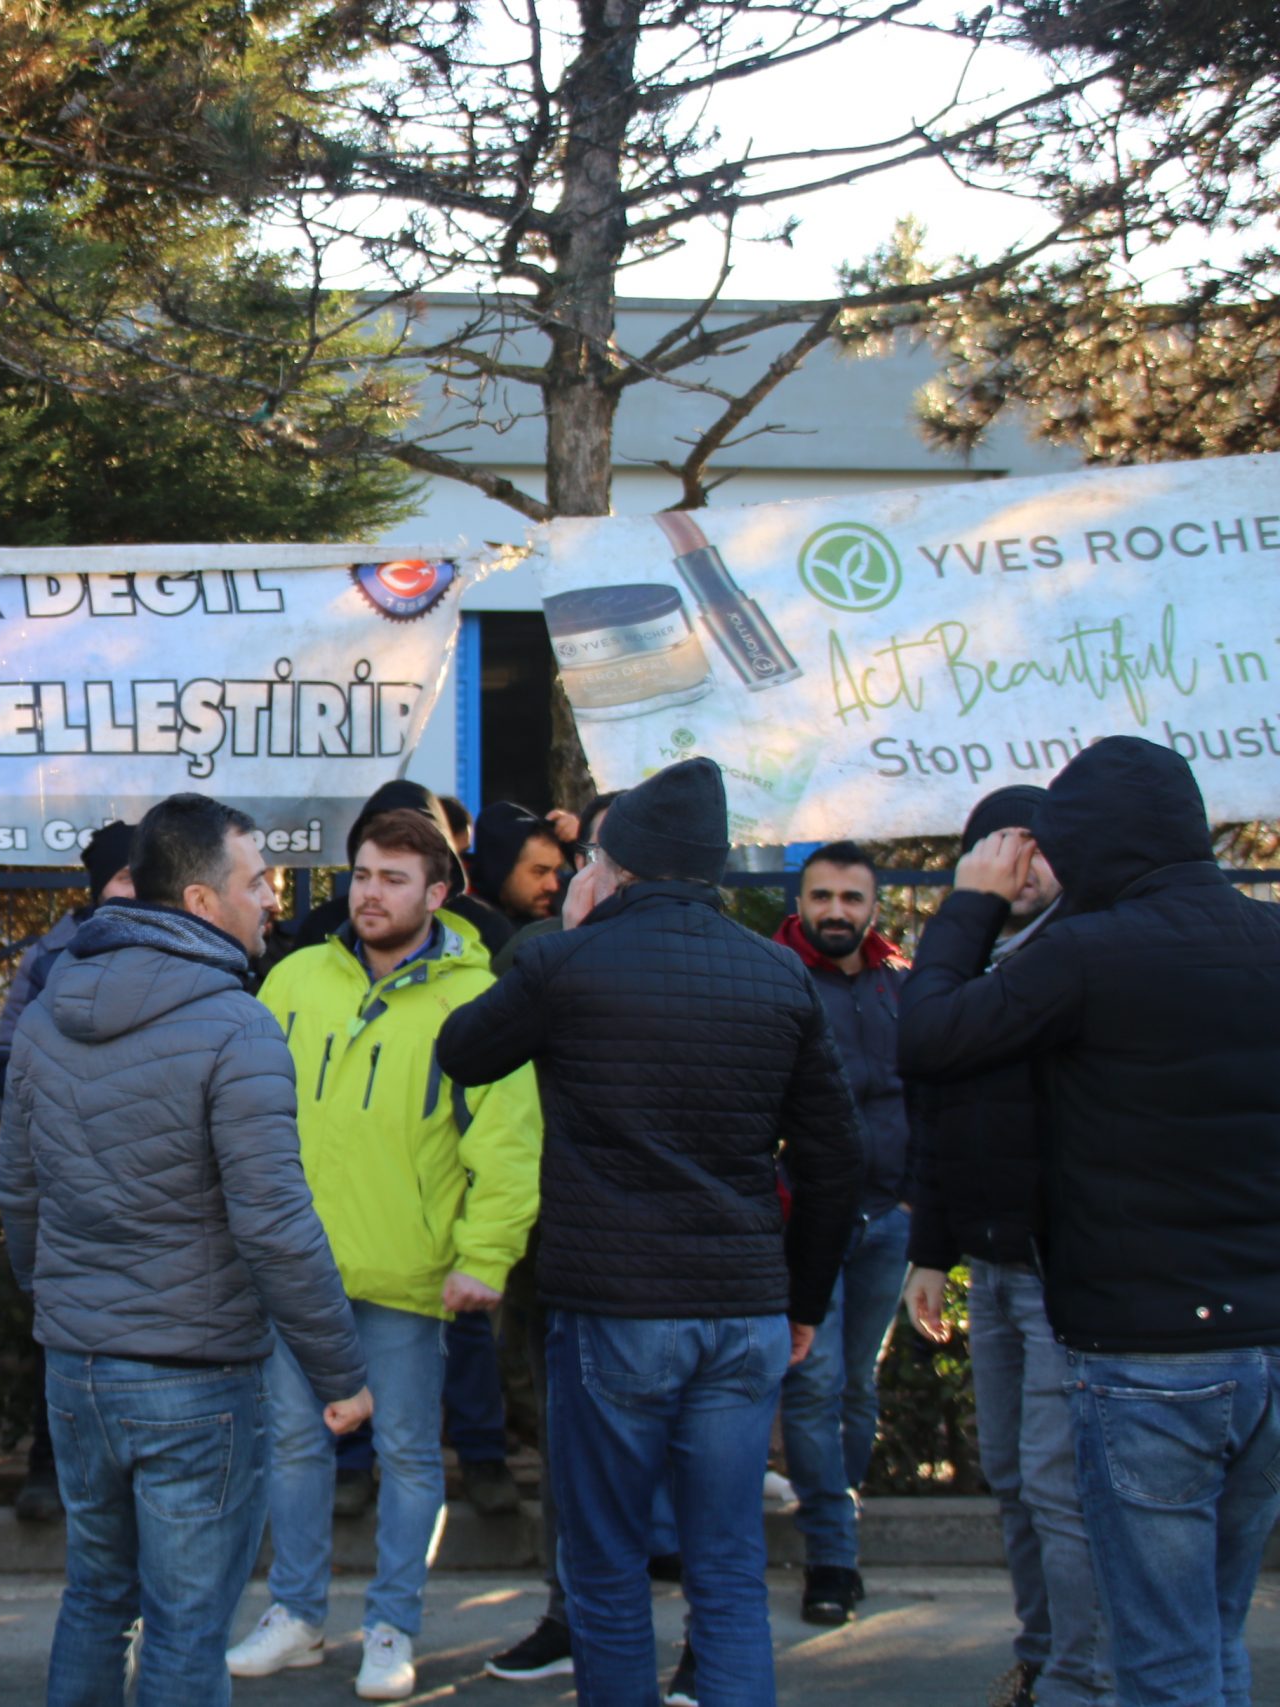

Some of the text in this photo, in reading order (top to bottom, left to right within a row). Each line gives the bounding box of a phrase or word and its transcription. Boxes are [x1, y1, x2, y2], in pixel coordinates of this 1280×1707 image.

[919, 514, 1280, 578] YVES ROCHE
[580, 635, 620, 652] YVES
[828, 620, 1270, 728] Act Beautiful in
[870, 712, 1280, 784] Stop uni bust
